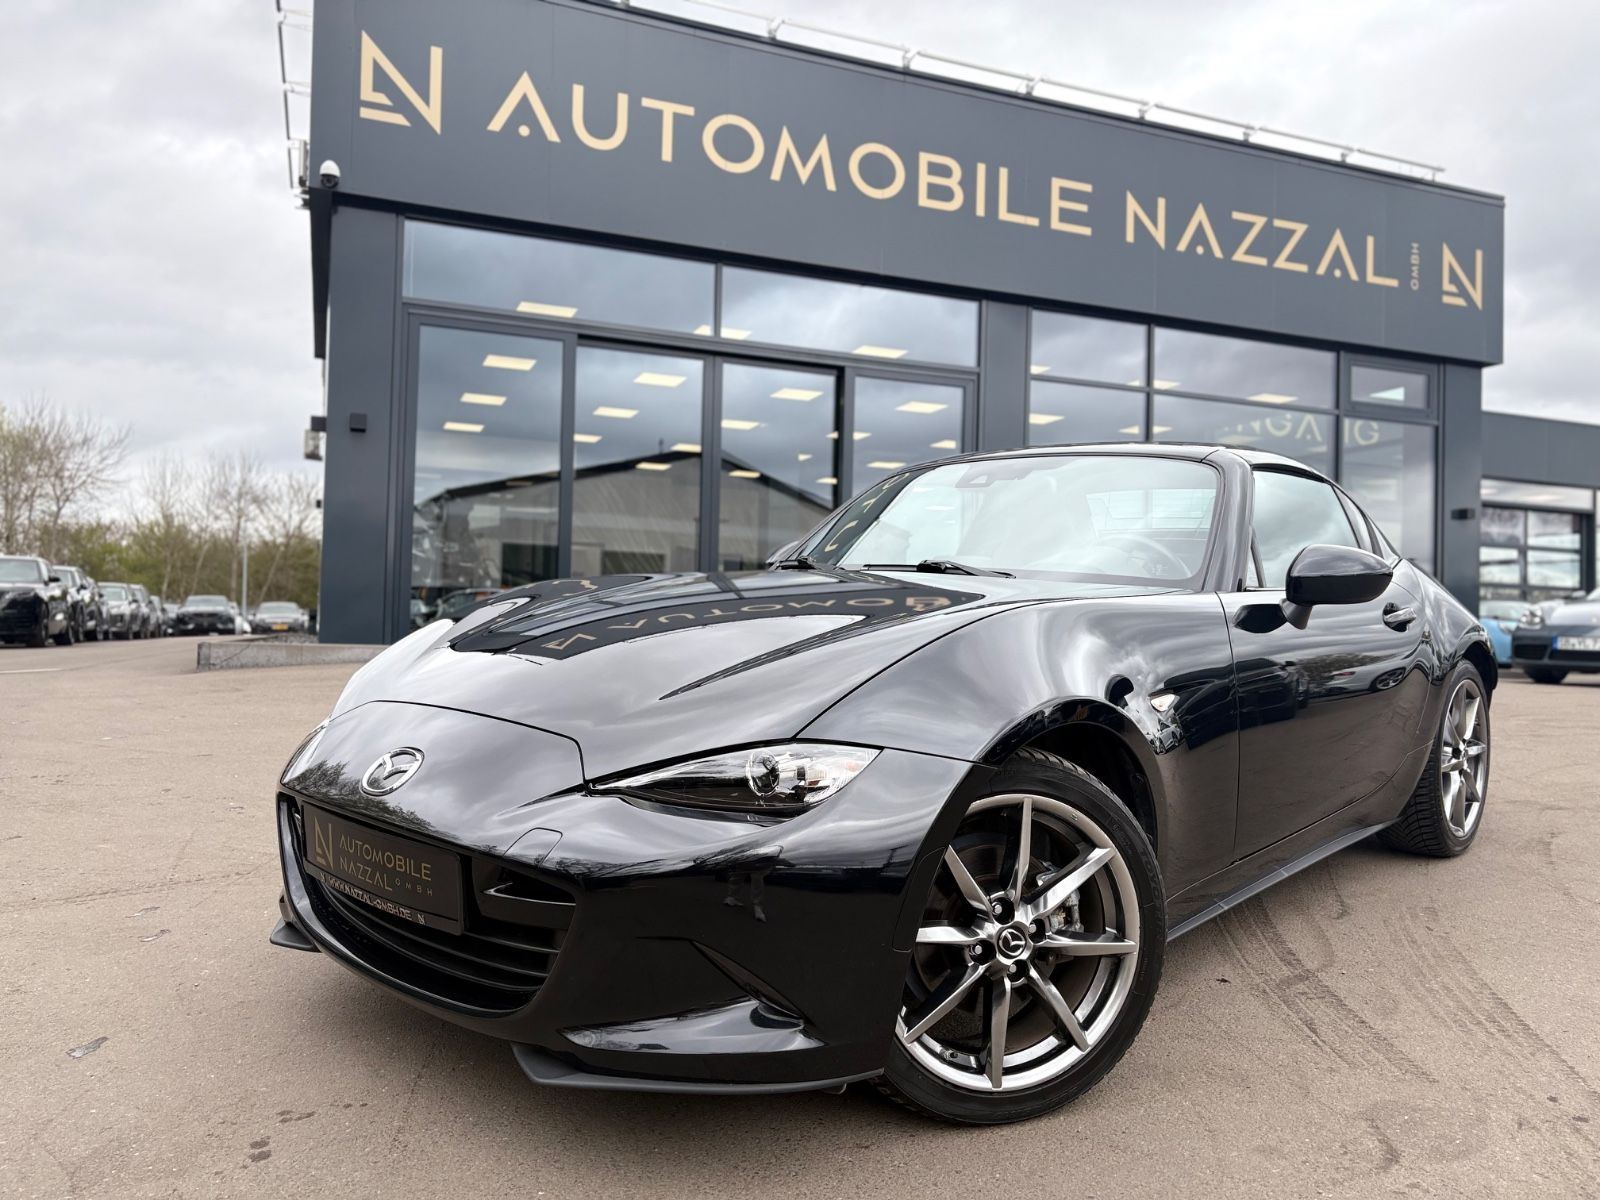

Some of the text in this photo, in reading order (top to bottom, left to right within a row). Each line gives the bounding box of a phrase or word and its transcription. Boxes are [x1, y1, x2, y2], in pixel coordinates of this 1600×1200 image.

[487, 72, 1093, 236] AUTOMOBILE
[1126, 190, 1400, 288] NAZZAL
[339, 834, 432, 881] AUTOMOBILE
[340, 855, 393, 891] NAZZAL
